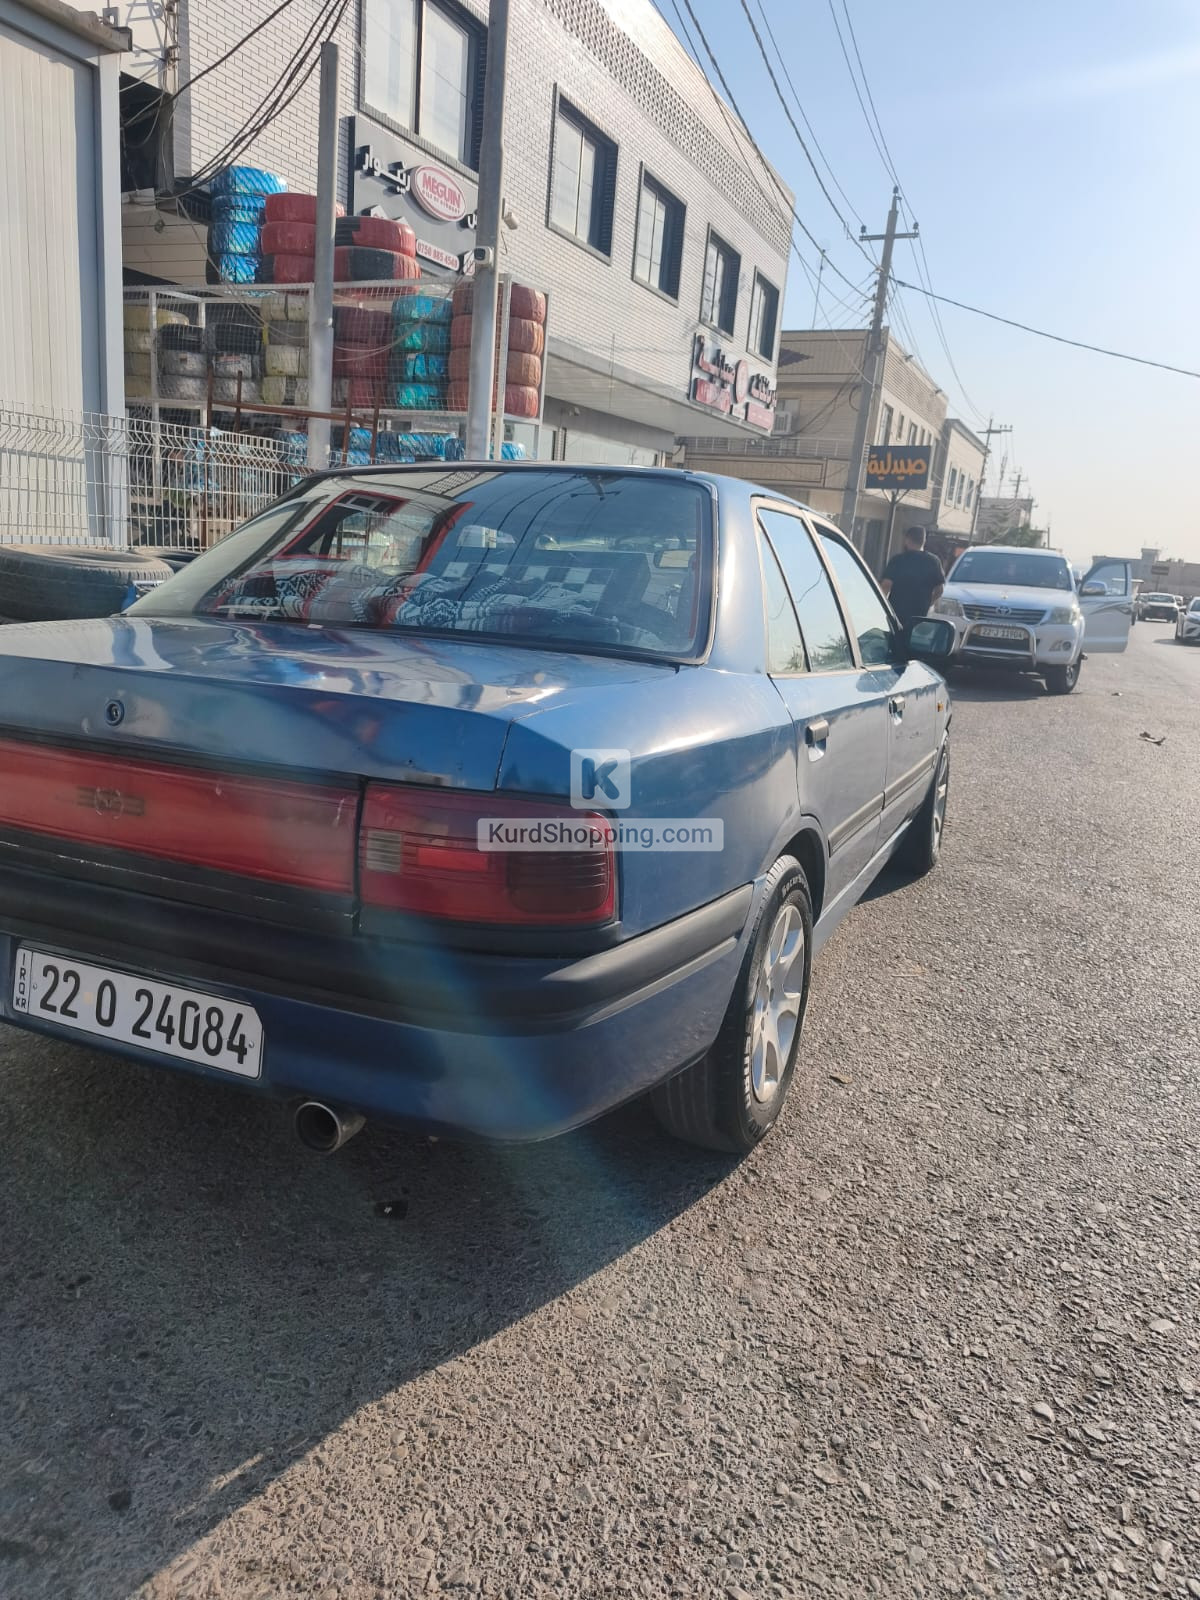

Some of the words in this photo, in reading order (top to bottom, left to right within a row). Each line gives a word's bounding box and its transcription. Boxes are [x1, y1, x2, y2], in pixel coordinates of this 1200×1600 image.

[15, 997, 27, 1009] KR
[39, 964, 81, 1019] 22
[131, 988, 248, 1065] 24084
